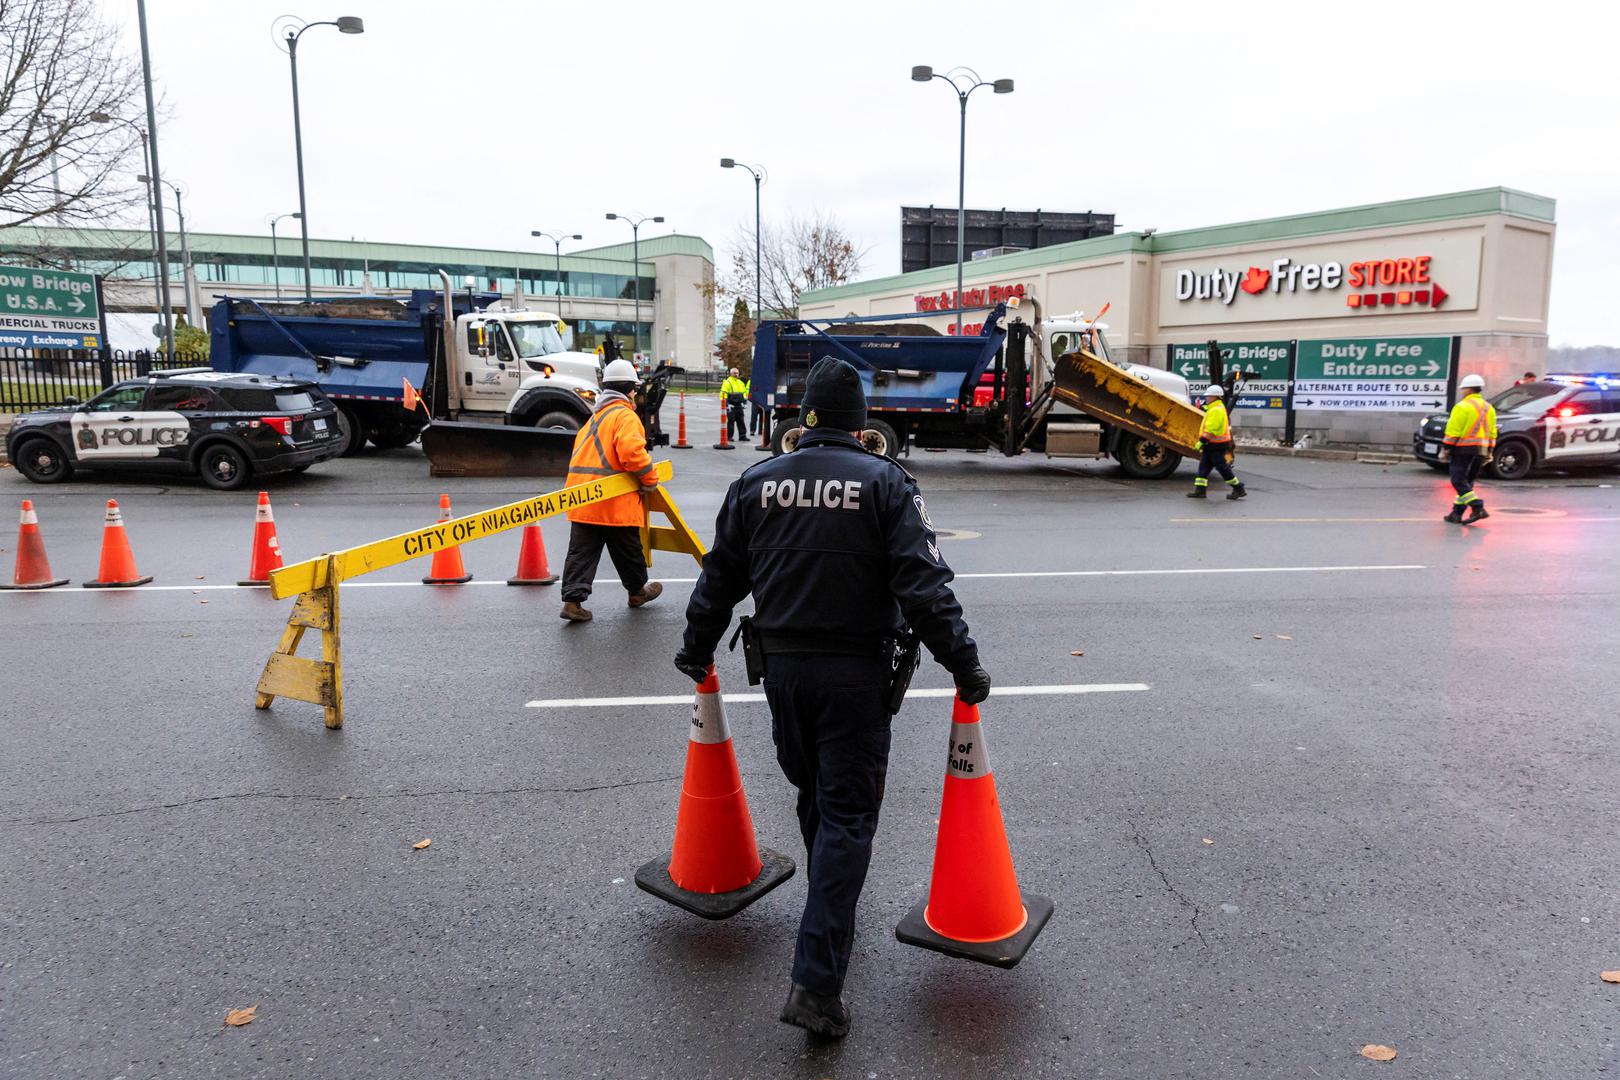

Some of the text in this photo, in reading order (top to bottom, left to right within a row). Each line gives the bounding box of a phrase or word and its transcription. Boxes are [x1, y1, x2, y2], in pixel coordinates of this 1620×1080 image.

[32, 274, 92, 296] Bridge
[1175, 256, 1431, 305] Duty Free STORE
[6, 293, 62, 311] U.S.A.
[940, 291, 950, 310] &
[988, 283, 1025, 304] Free
[51, 320, 96, 331] TRUCKS
[32, 335, 79, 347] Exchange
[1238, 345, 1287, 362] Bridge
[1321, 342, 1422, 361] Duty Free
[1323, 361, 1417, 376] Entrance
[1249, 383, 1286, 392] TRUCKS
[1297, 383, 1444, 393] ALTERNATE ROUTE TO U.S.A.
[1319, 399, 1342, 407] NOW
[1343, 399, 1367, 407] OPEN
[102, 426, 190, 446] POLICE
[761, 479, 862, 510] POLICE
[403, 484, 604, 556] CITY OF NIAGARA FALLS
[958, 742, 973, 755] of
